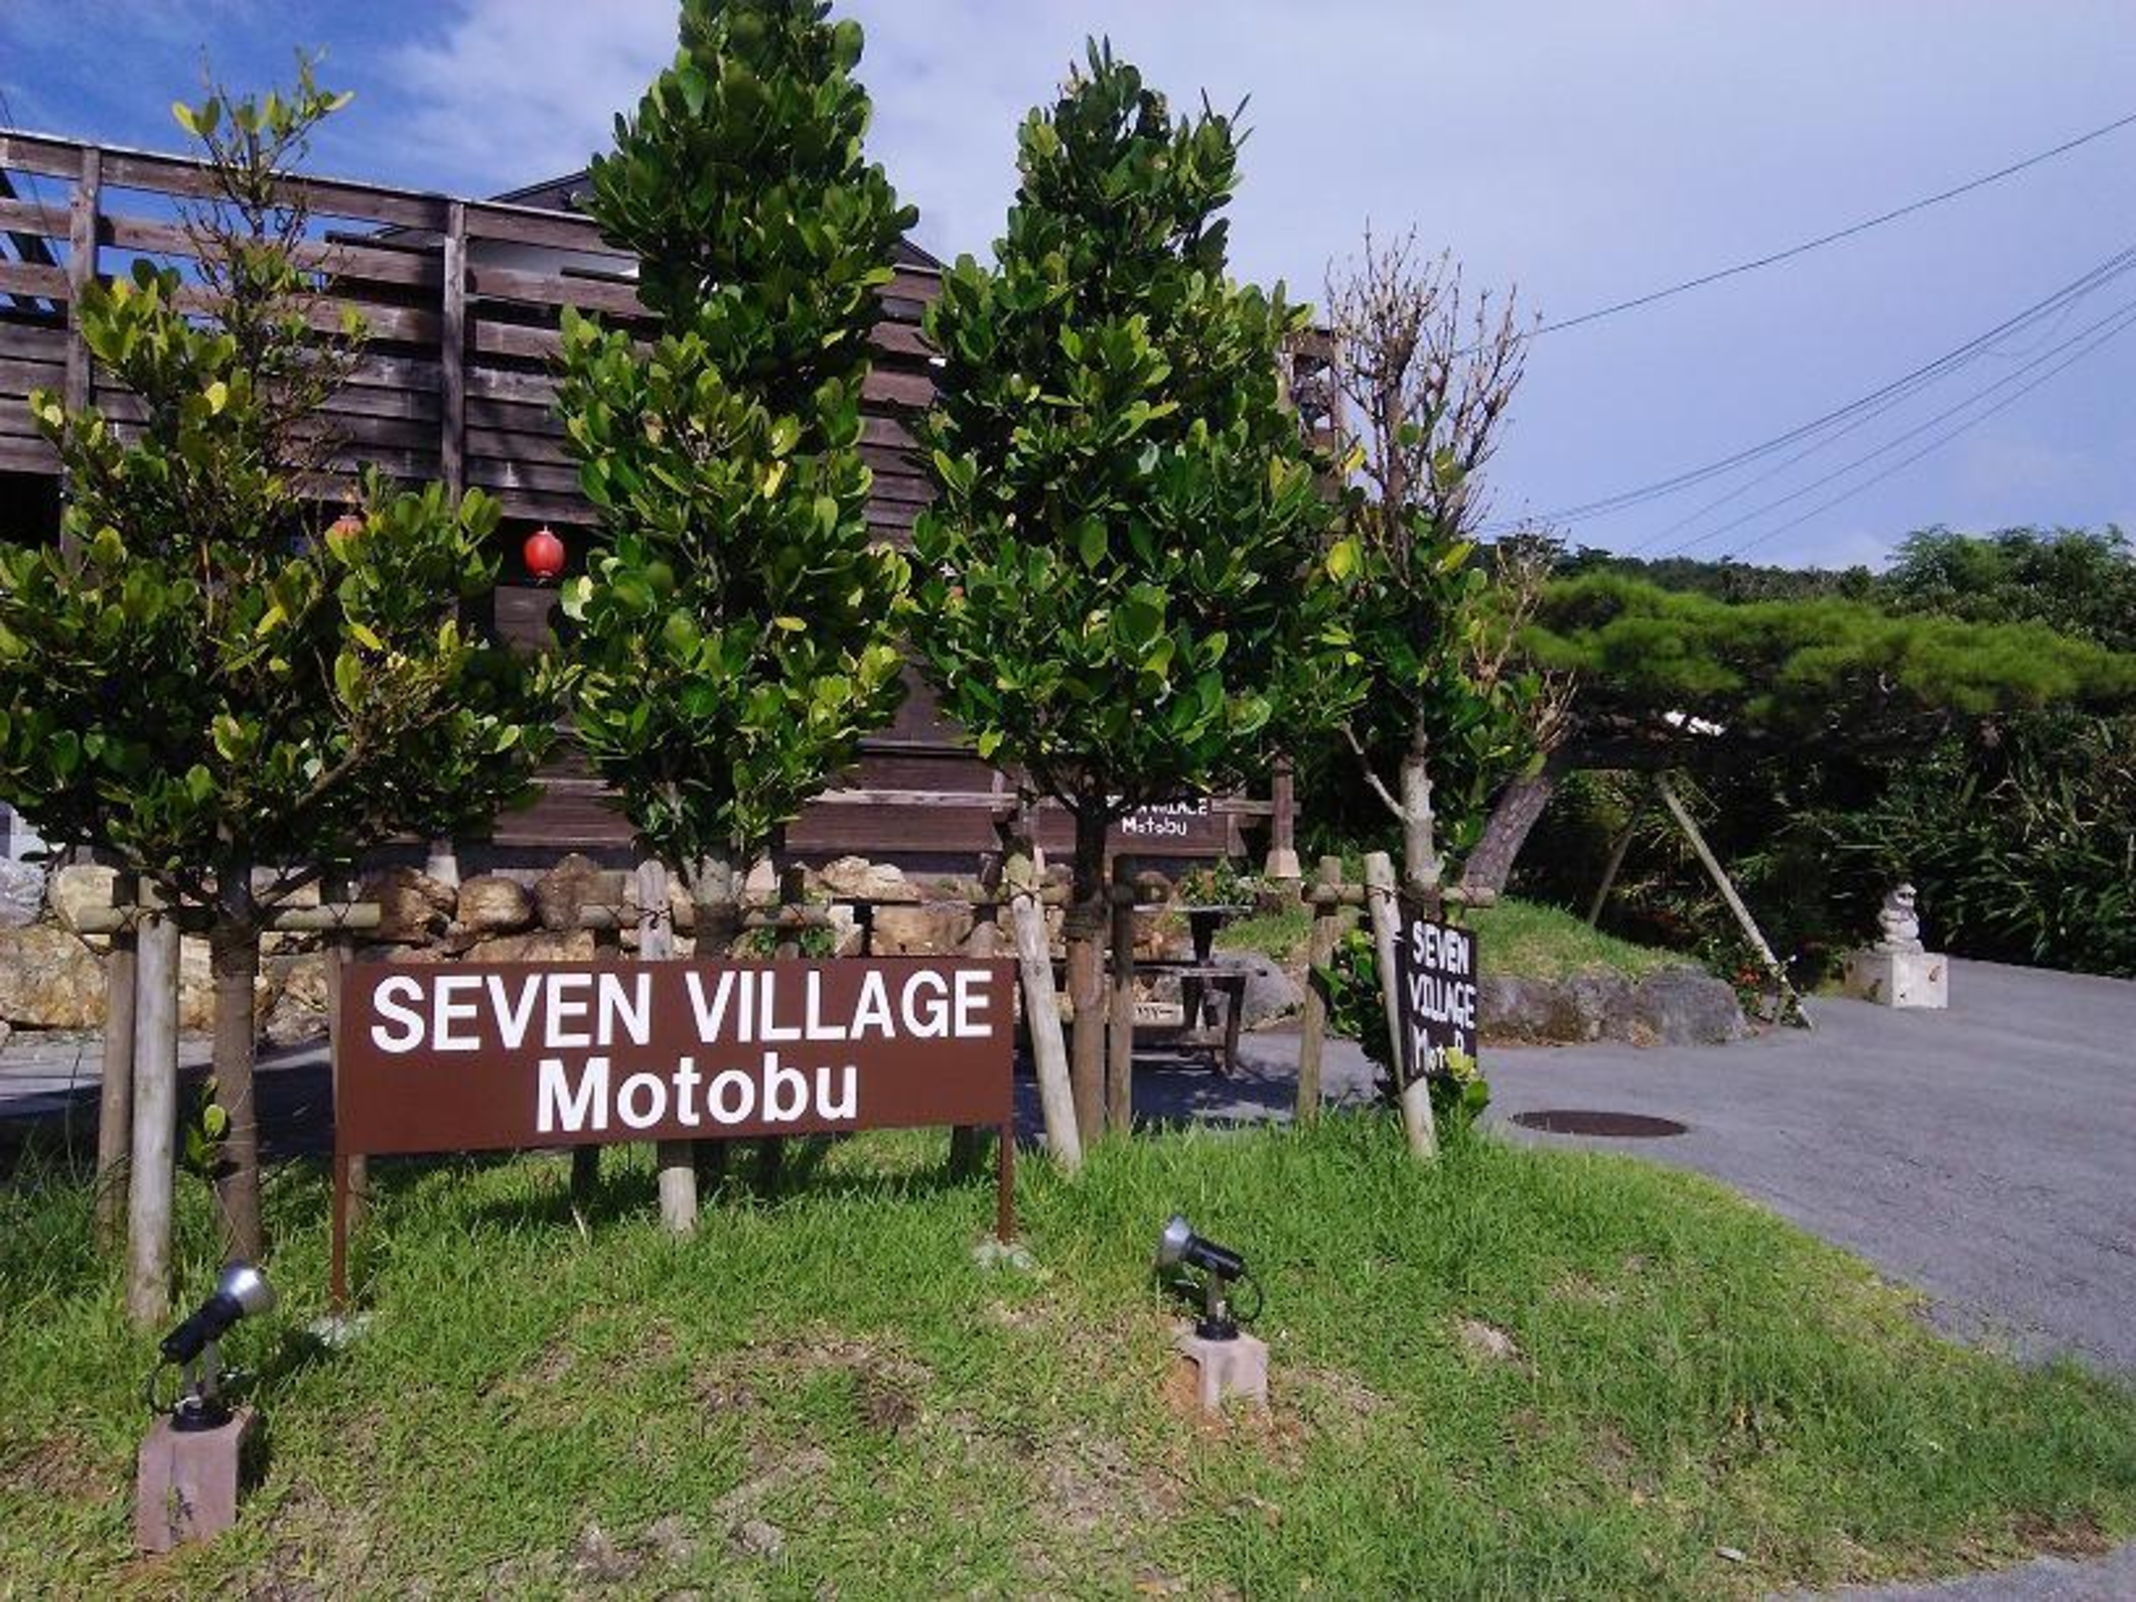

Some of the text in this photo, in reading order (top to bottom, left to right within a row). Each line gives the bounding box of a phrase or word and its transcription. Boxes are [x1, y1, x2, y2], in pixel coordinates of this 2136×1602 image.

[1121, 816, 1187, 836] Motobu
[1412, 920, 1469, 975] SEVEN
[371, 970, 993, 1053] SEVEN VILLAGE
[1407, 971, 1476, 1030] VILLAGE
[536, 1052, 858, 1133] Motobu
